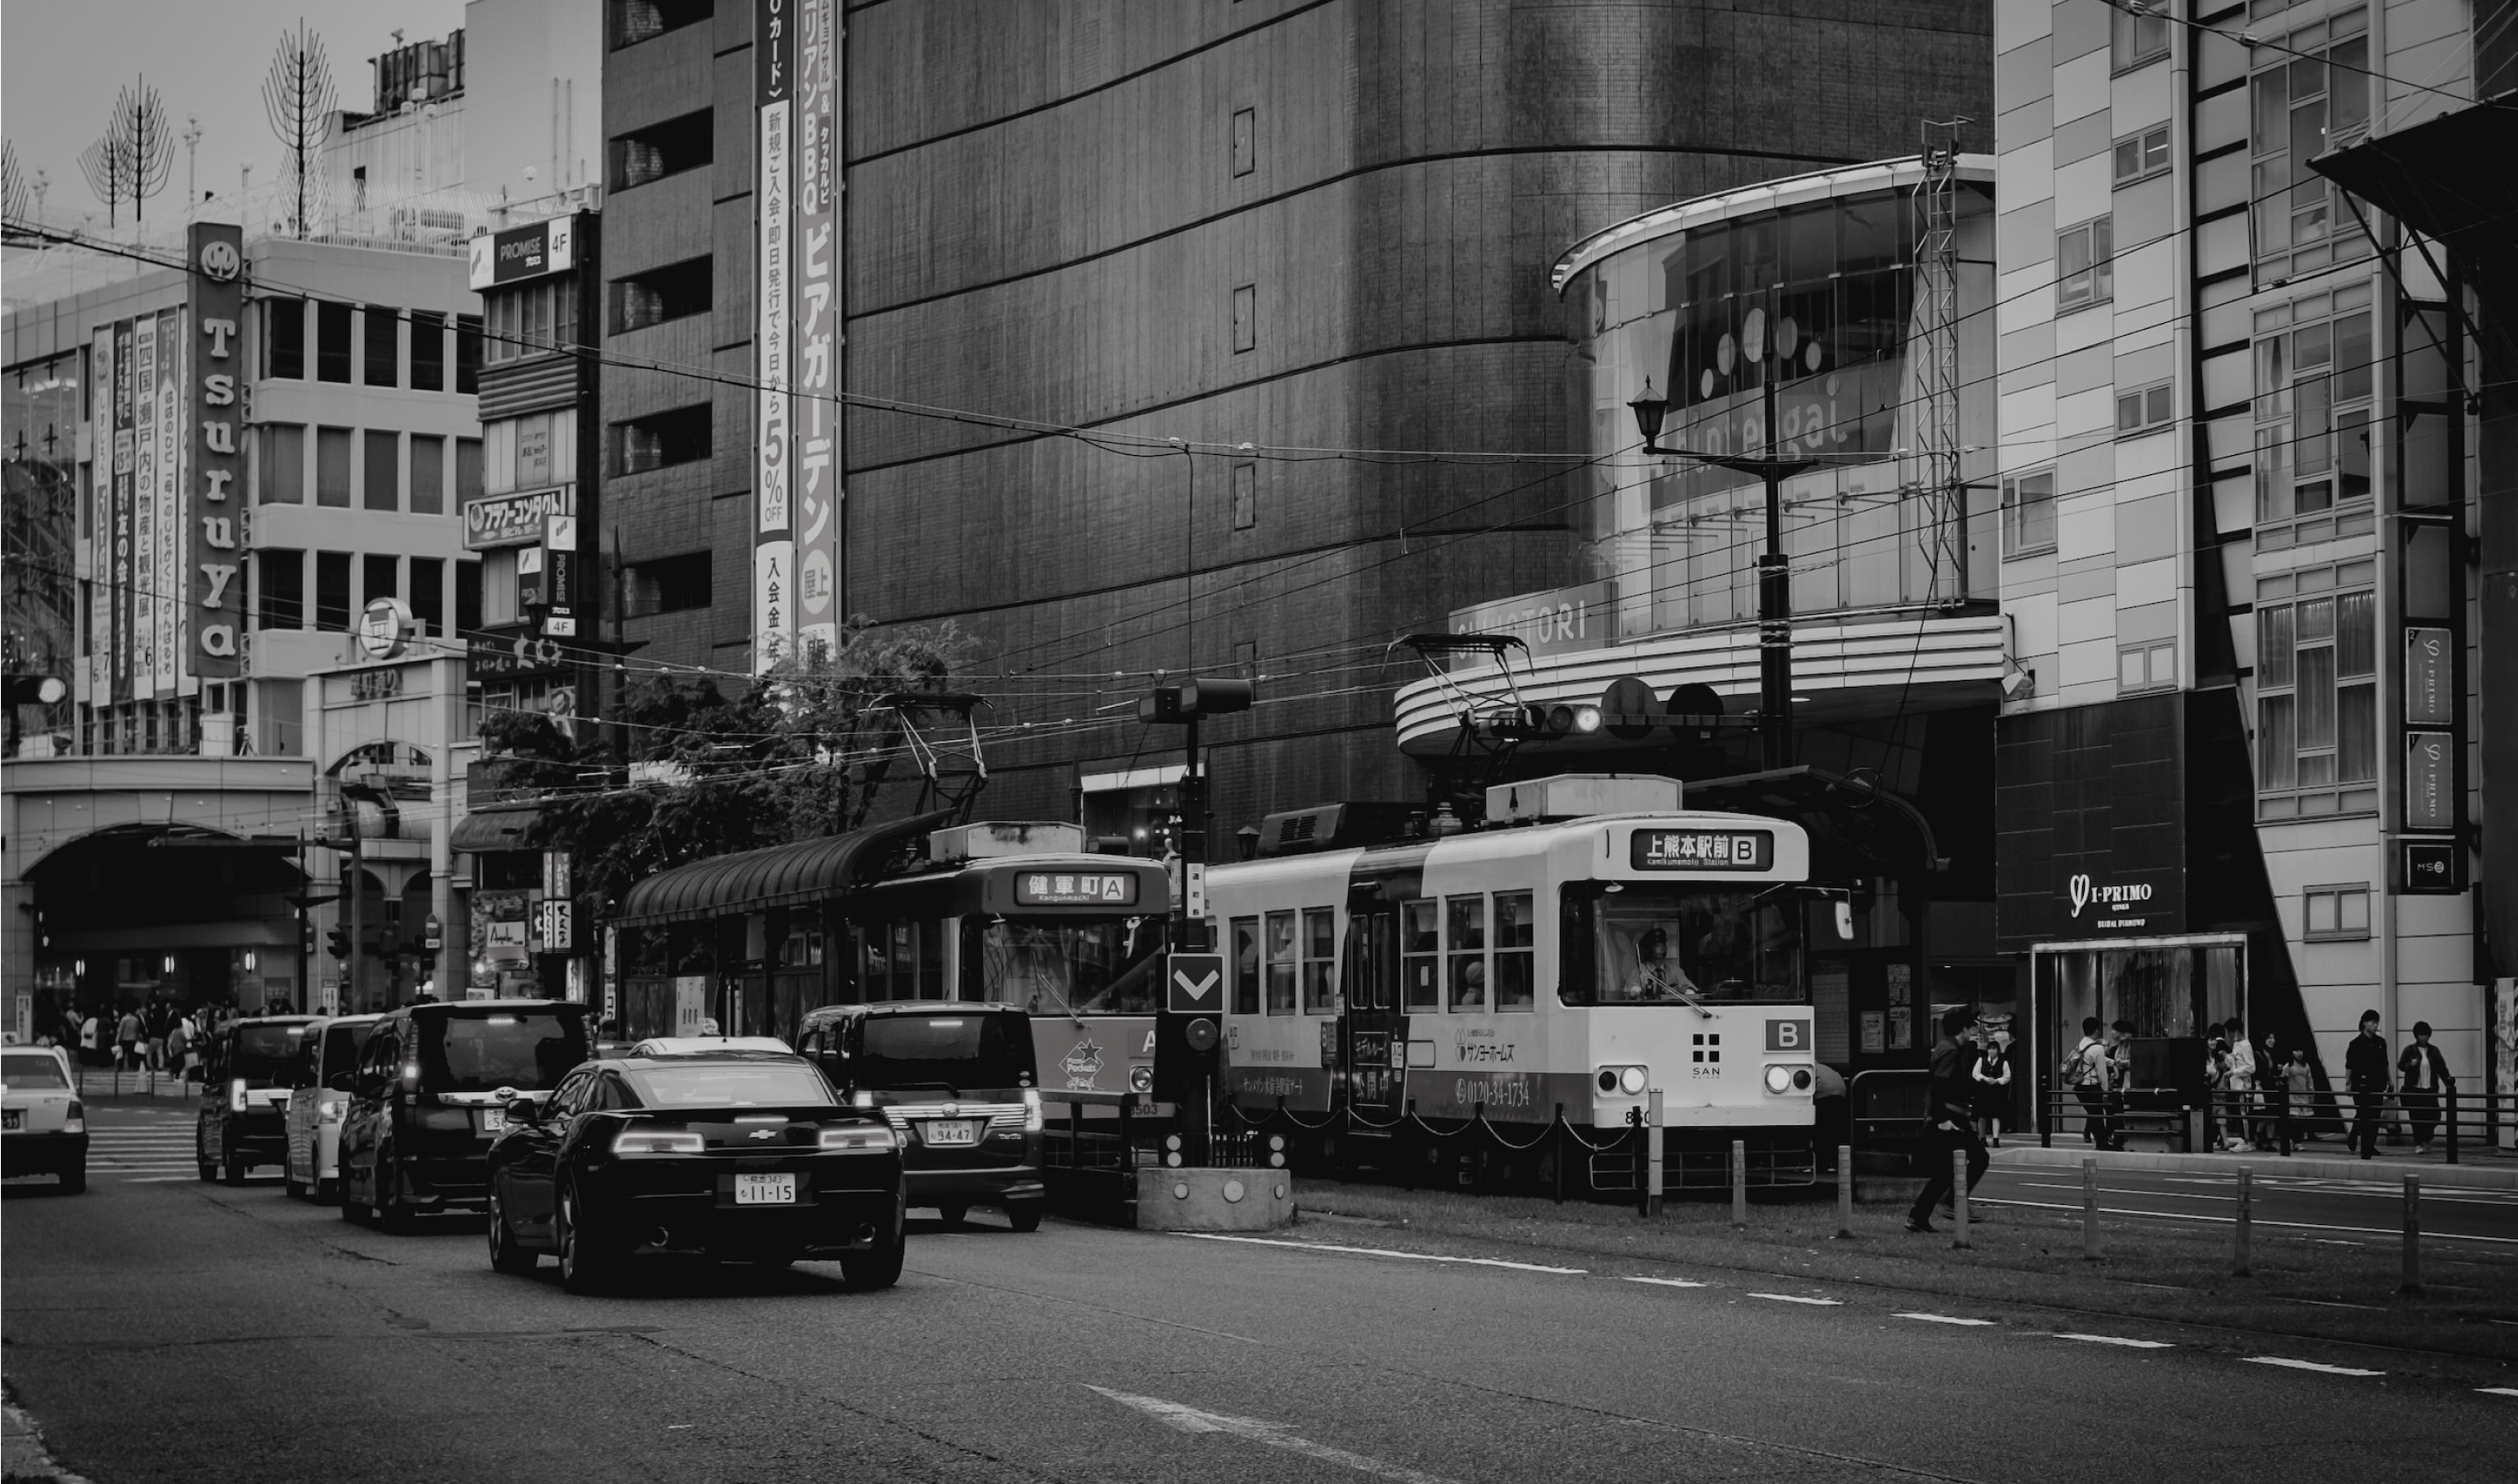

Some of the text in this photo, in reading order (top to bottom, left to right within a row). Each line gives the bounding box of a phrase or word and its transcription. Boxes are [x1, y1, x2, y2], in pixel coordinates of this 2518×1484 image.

[500, 233, 567, 262] PROMISE 4F
[202, 318, 236, 657] Tsuruya
[484, 493, 559, 530] フラワーコンタクト
[556, 554, 566, 603] PROMISE
[553, 621, 569, 633] 4F
[2409, 630, 2416, 640] 2
[1646, 834, 1752, 860] 上熊本駅前 B
[1028, 875, 1121, 897] 健軍町 A
[2090, 884, 2152, 903] I-PRIMO
[1142, 1030, 1155, 1053] A
[1778, 1022, 1799, 1047] B
[1693, 1067, 1720, 1076] SAN
[1467, 1081, 1529, 1108] 0120-34-1734
[938, 1130, 971, 1141] 94-47
[751, 1185, 792, 1201] 11-15
